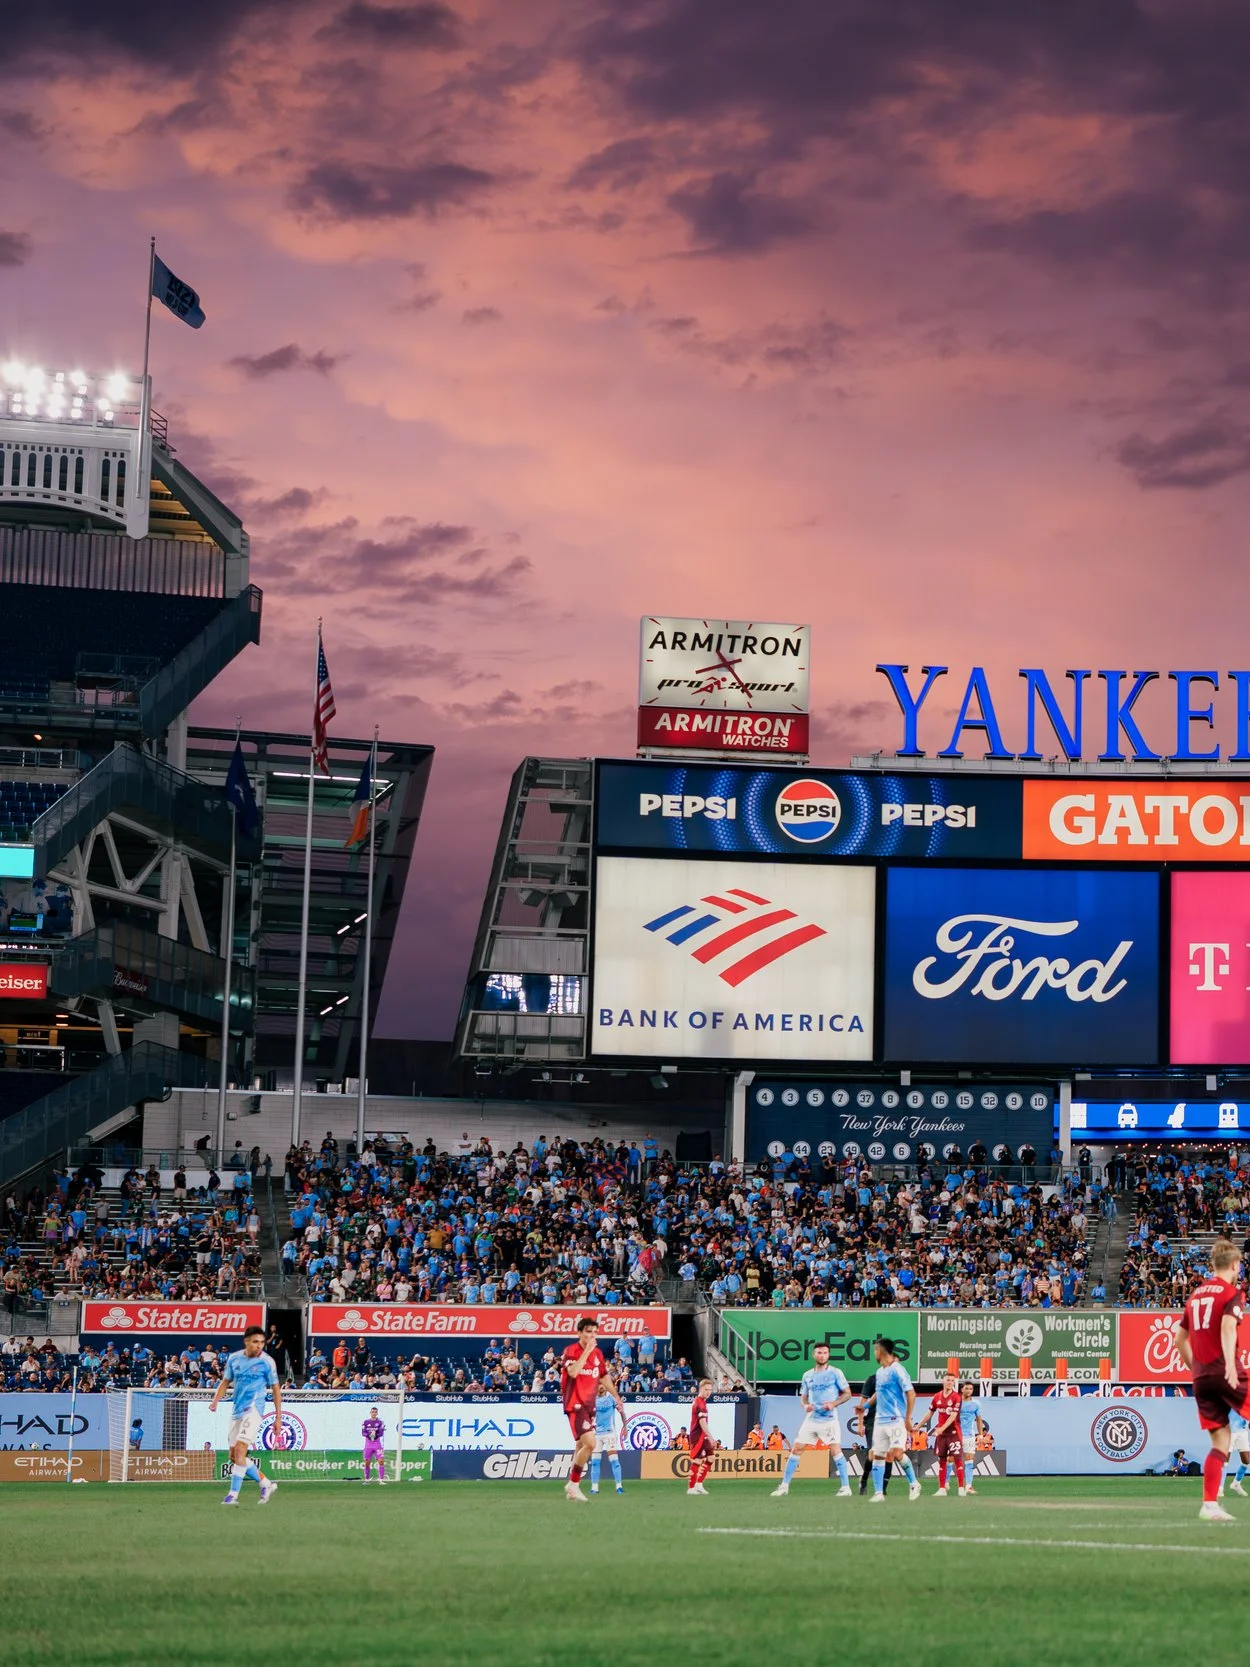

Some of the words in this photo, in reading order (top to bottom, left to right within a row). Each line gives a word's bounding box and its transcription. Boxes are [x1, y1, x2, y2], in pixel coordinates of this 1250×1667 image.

[649, 631, 801, 657] ARMITRON
[654, 713, 792, 737] ARMITRON
[722, 734, 789, 748] WATCHES
[639, 793, 736, 820] PEPSI
[780, 801, 837, 820] PEPSI
[881, 803, 976, 828] PEPSI
[913, 914, 1134, 1002] Ford
[1189, 943, 1230, 991] T
[0, 975, 42, 990] eiser
[598, 1008, 679, 1030] BANK
[688, 1012, 725, 1031] OF
[732, 1013, 865, 1034] AMERICA
[761, 1093, 768, 1101] 4
[787, 1093, 794, 1101] 3
[812, 1093, 819, 1102] 5
[837, 1094, 844, 1103] 7
[859, 1094, 872, 1103] 37
[887, 1095, 894, 1104] 8
[911, 1096, 918, 1105] 8
[935, 1096, 945, 1105] 16
[960, 1096, 970, 1105] 15
[983, 1097, 995, 1106] 32
[1011, 1097, 1017, 1106] 9
[1034, 1098, 1044, 1107] 10
[840, 1114, 872, 1130] New
[873, 1115, 909, 1138] York
[909, 1116, 966, 1139] Yankees
[795, 1145, 807, 1154] 44
[821, 1146, 833, 1155] 23
[845, 1146, 857, 1155] 49
[870, 1146, 882, 1155] 42
[898, 1147, 905, 1156] 6
[1191, 1296, 1215, 1330] 17
[541, 1312, 645, 1333] StatFarm
[927, 1315, 1002, 1335] Morningside
[1044, 1315, 1110, 1331] Workmen's
[959, 1342, 987, 1350] Nursing
[988, 1341, 1001, 1349] and
[1073, 1331, 1110, 1347] Circle
[927, 1350, 976, 1358] Rehabilitation
[977, 1350, 1002, 1358] Center
[1051, 1350, 1083, 1358] MultiCare
[1084, 1350, 1110, 1358] Center
[982, 1381, 990, 1397] Y
[1019, 1382, 1027, 1397] C
[1058, 1382, 1066, 1397] F
[1102, 1383, 1111, 1397] C
[257, 1417, 270, 1434] NEW
[396, 1418, 535, 1437] ETIHAD
[1096, 1415, 1109, 1430] NEW
[1109, 1409, 1130, 1417] YORK
[1130, 1414, 1143, 1430] CITY
[657, 1422, 669, 1435] CITY
[949, 1441, 961, 1451] 23
[1095, 1437, 1129, 1458] FOOTBALL
[1129, 1436, 1144, 1455] CLUB
[14, 1457, 84, 1467] ETIHAD
[121, 1456, 189, 1466] ETIHAD
[269, 1460, 285, 1470] The
[287, 1460, 345, 1472] Quicker
[347, 1459, 385, 1470] Pice
[671, 1453, 783, 1478] Coinental
[134, 1468, 174, 1476] AIRWAYS
